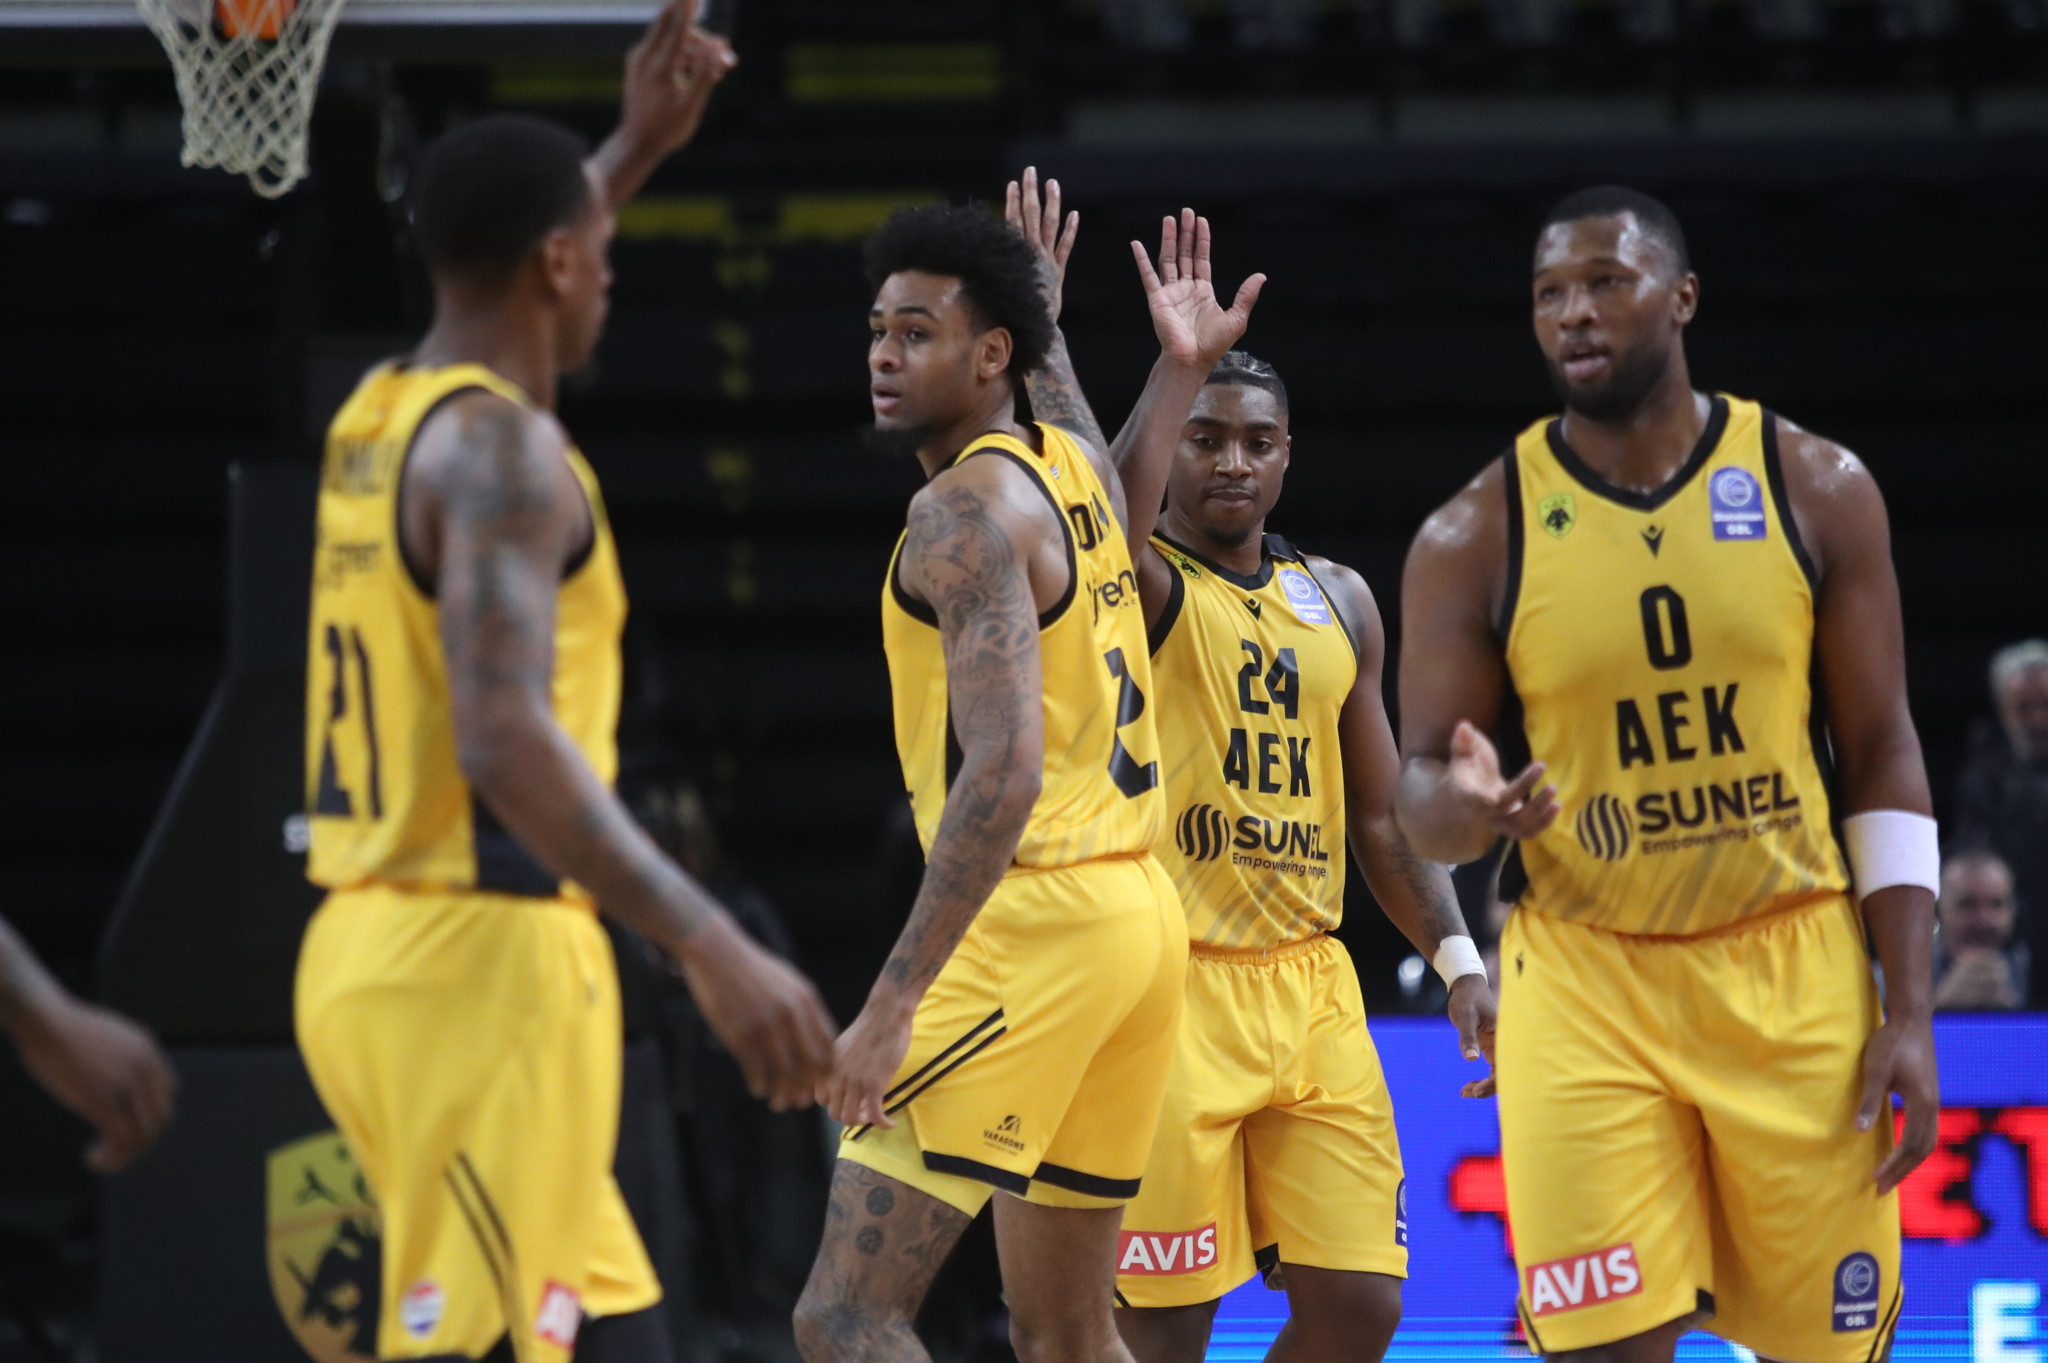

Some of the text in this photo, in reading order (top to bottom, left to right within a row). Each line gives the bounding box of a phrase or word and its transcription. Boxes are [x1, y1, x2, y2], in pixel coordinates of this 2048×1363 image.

[1639, 584, 1693, 671] 0
[1238, 638, 1300, 720] 24
[1616, 683, 1746, 770] AEK
[1223, 727, 1312, 797] AEK
[1635, 771, 1800, 835] SUNEL
[1232, 852, 1306, 877] Empowering
[1641, 828, 1749, 855] Empowering
[1119, 1228, 1217, 1272] AVIS
[1531, 1247, 1639, 1313] AVIS
